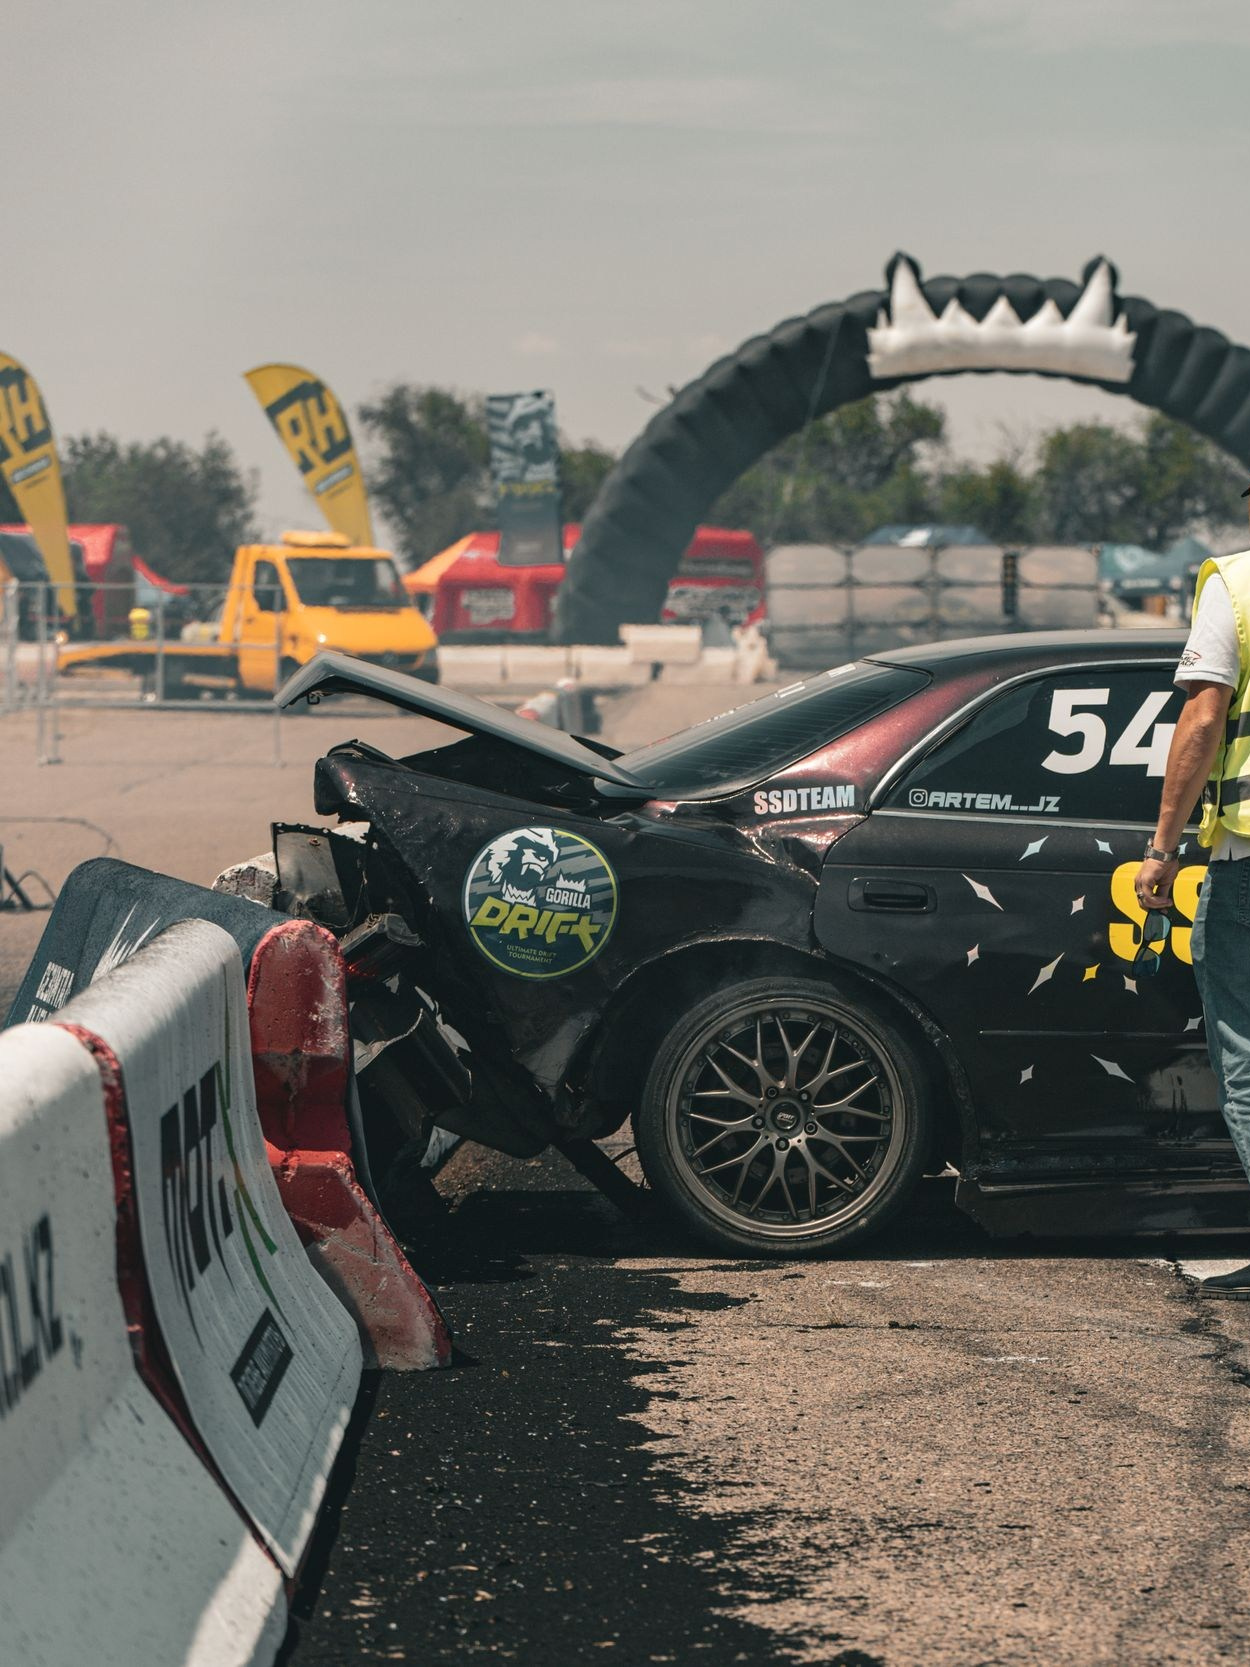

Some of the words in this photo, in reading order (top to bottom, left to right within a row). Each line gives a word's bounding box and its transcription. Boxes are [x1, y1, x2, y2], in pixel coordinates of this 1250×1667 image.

[1041, 687, 1174, 777] 54
[753, 784, 856, 815] SSDTEAM
[545, 887, 591, 909] GORILLA
[469, 895, 602, 954] DRIFT
[506, 944, 537, 956] ULTIMATE
[538, 950, 557, 959] DRIFT
[508, 951, 553, 965] TOURNAMENT
